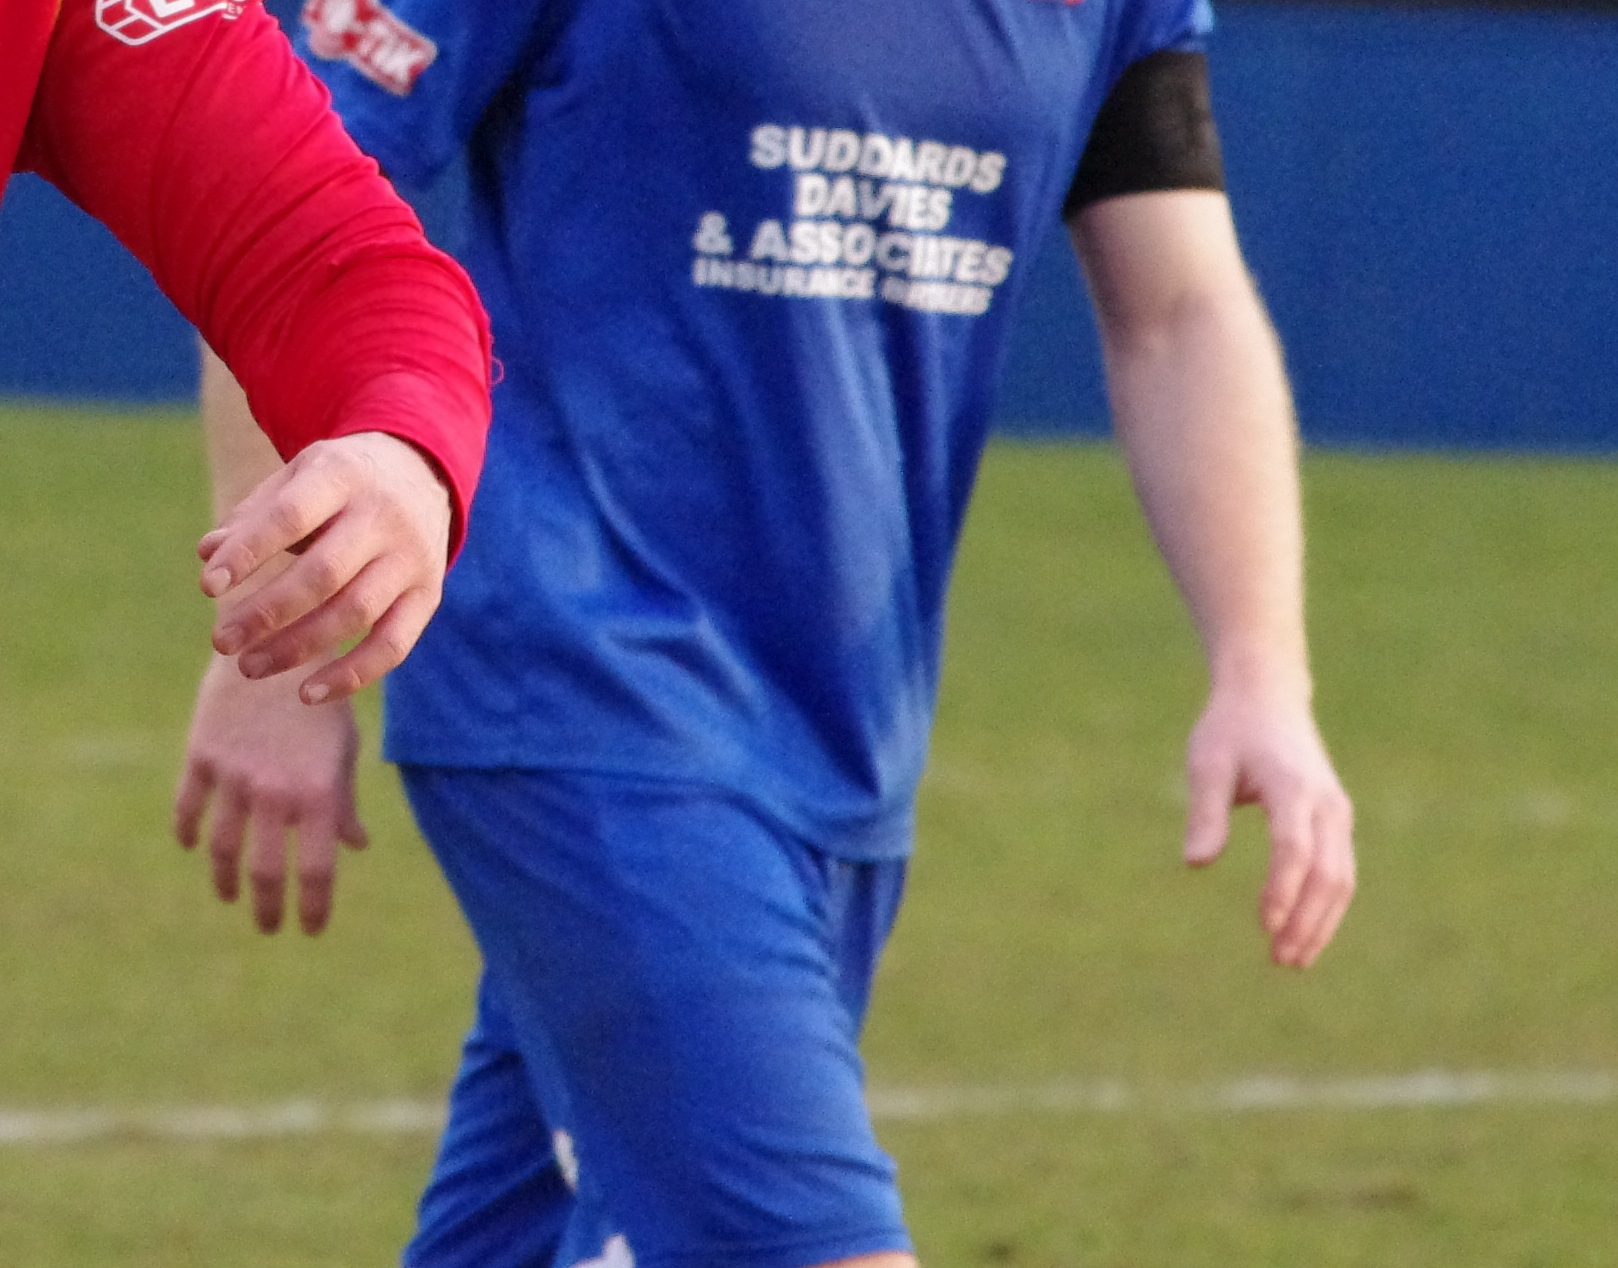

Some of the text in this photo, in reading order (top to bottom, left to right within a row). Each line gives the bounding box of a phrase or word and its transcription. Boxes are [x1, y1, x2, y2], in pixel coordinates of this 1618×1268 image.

[749, 123, 1008, 195] SUDDARDS
[794, 172, 955, 231] DAVIES
[692, 210, 733, 257] &
